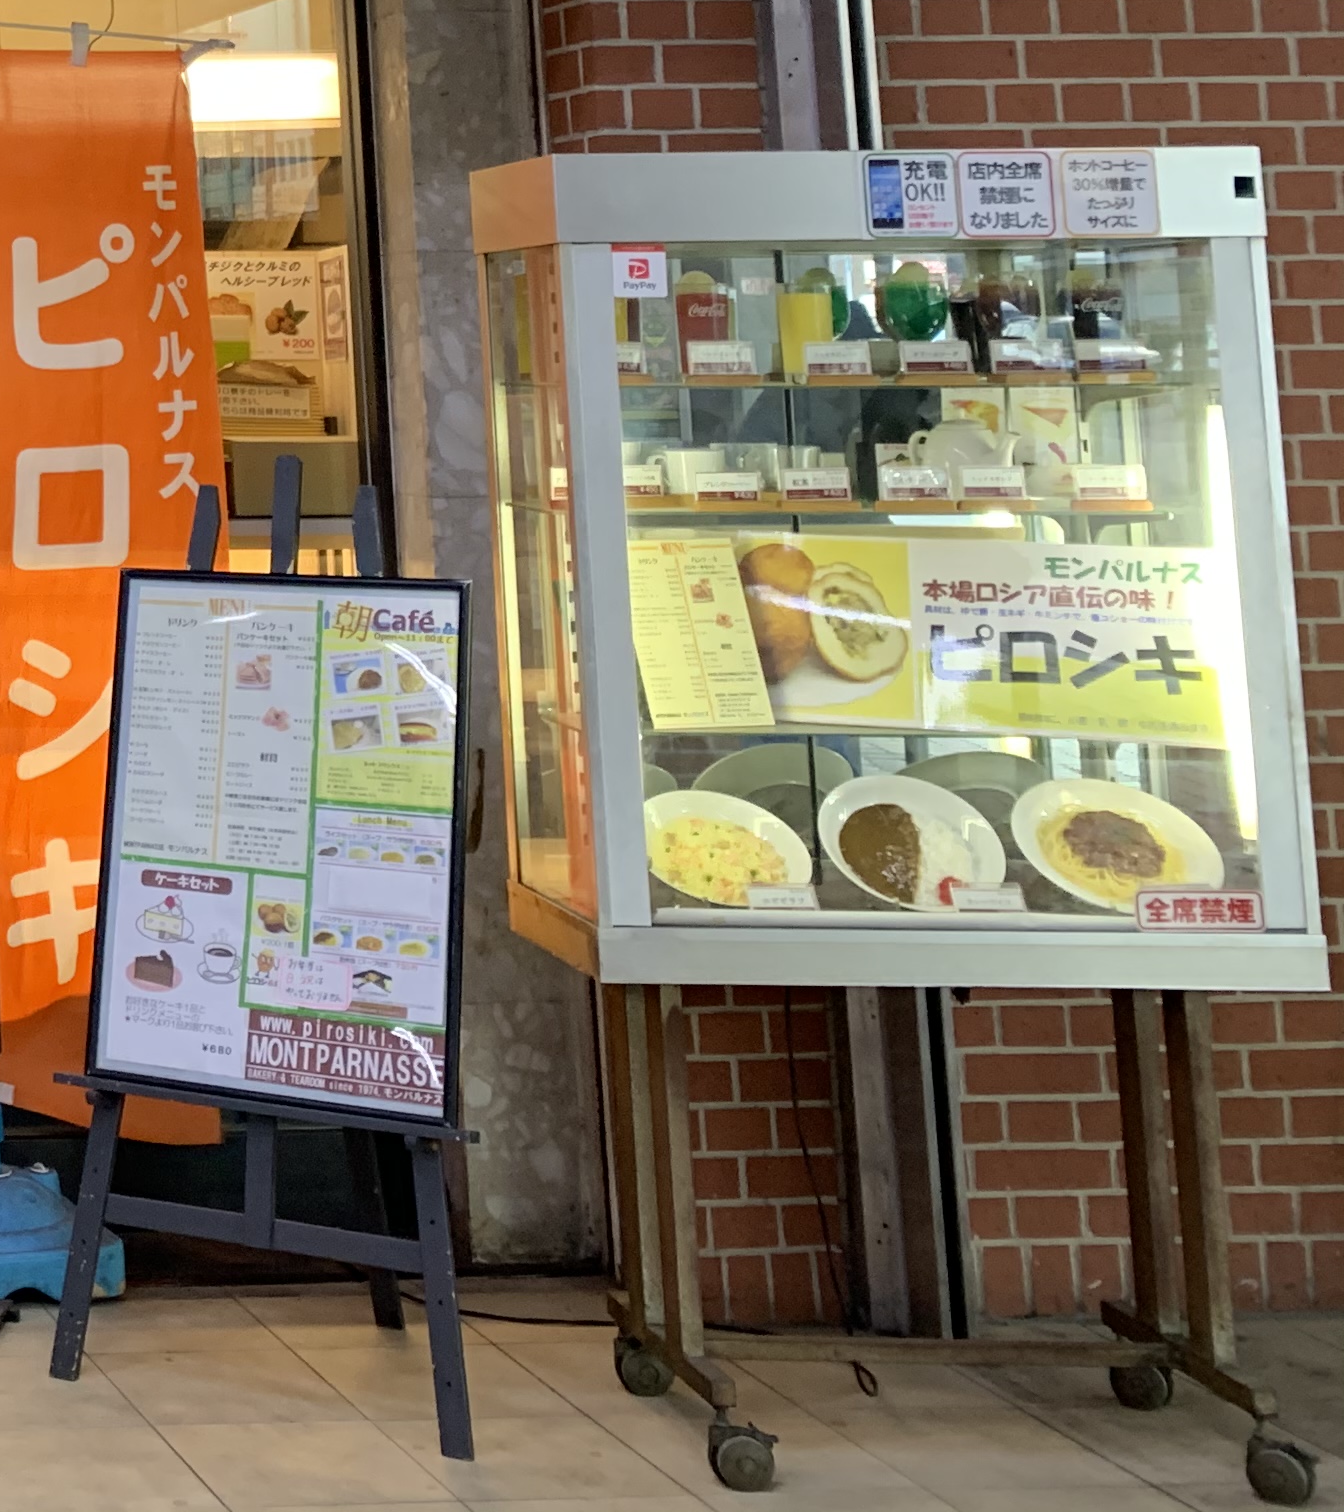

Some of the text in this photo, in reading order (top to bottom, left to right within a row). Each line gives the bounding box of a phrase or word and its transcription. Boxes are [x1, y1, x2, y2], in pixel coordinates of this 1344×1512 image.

[904, 160, 948, 181] 充電
[967, 161, 1043, 181] 店内全席
[1068, 158, 1149, 173] ホットコーヒー
[905, 184, 946, 203] OK!!
[979, 187, 1036, 205] 禁煙に
[1087, 197, 1136, 211] たっぷり
[969, 211, 1050, 230] なりました
[1086, 215, 1139, 230] サイズに
[623, 281, 657, 291] PayPay
[142, 164, 200, 500] モンパルナス
[1044, 556, 1203, 584] モンパルナス
[6, 222, 136, 986] ピロシキ
[332, 600, 435, 643] 朝 Café
[930, 623, 1203, 696] ピロシキ
[154, 871, 220, 892] ケーキセット
[1144, 897, 1257, 925] 全席禁煙
[202, 1042, 233, 1057] ¥680
[250, 1035, 444, 1089] MONTPARNASSE
[329, 1079, 354, 1094] since
[384, 1087, 444, 1105] モンパルナス
